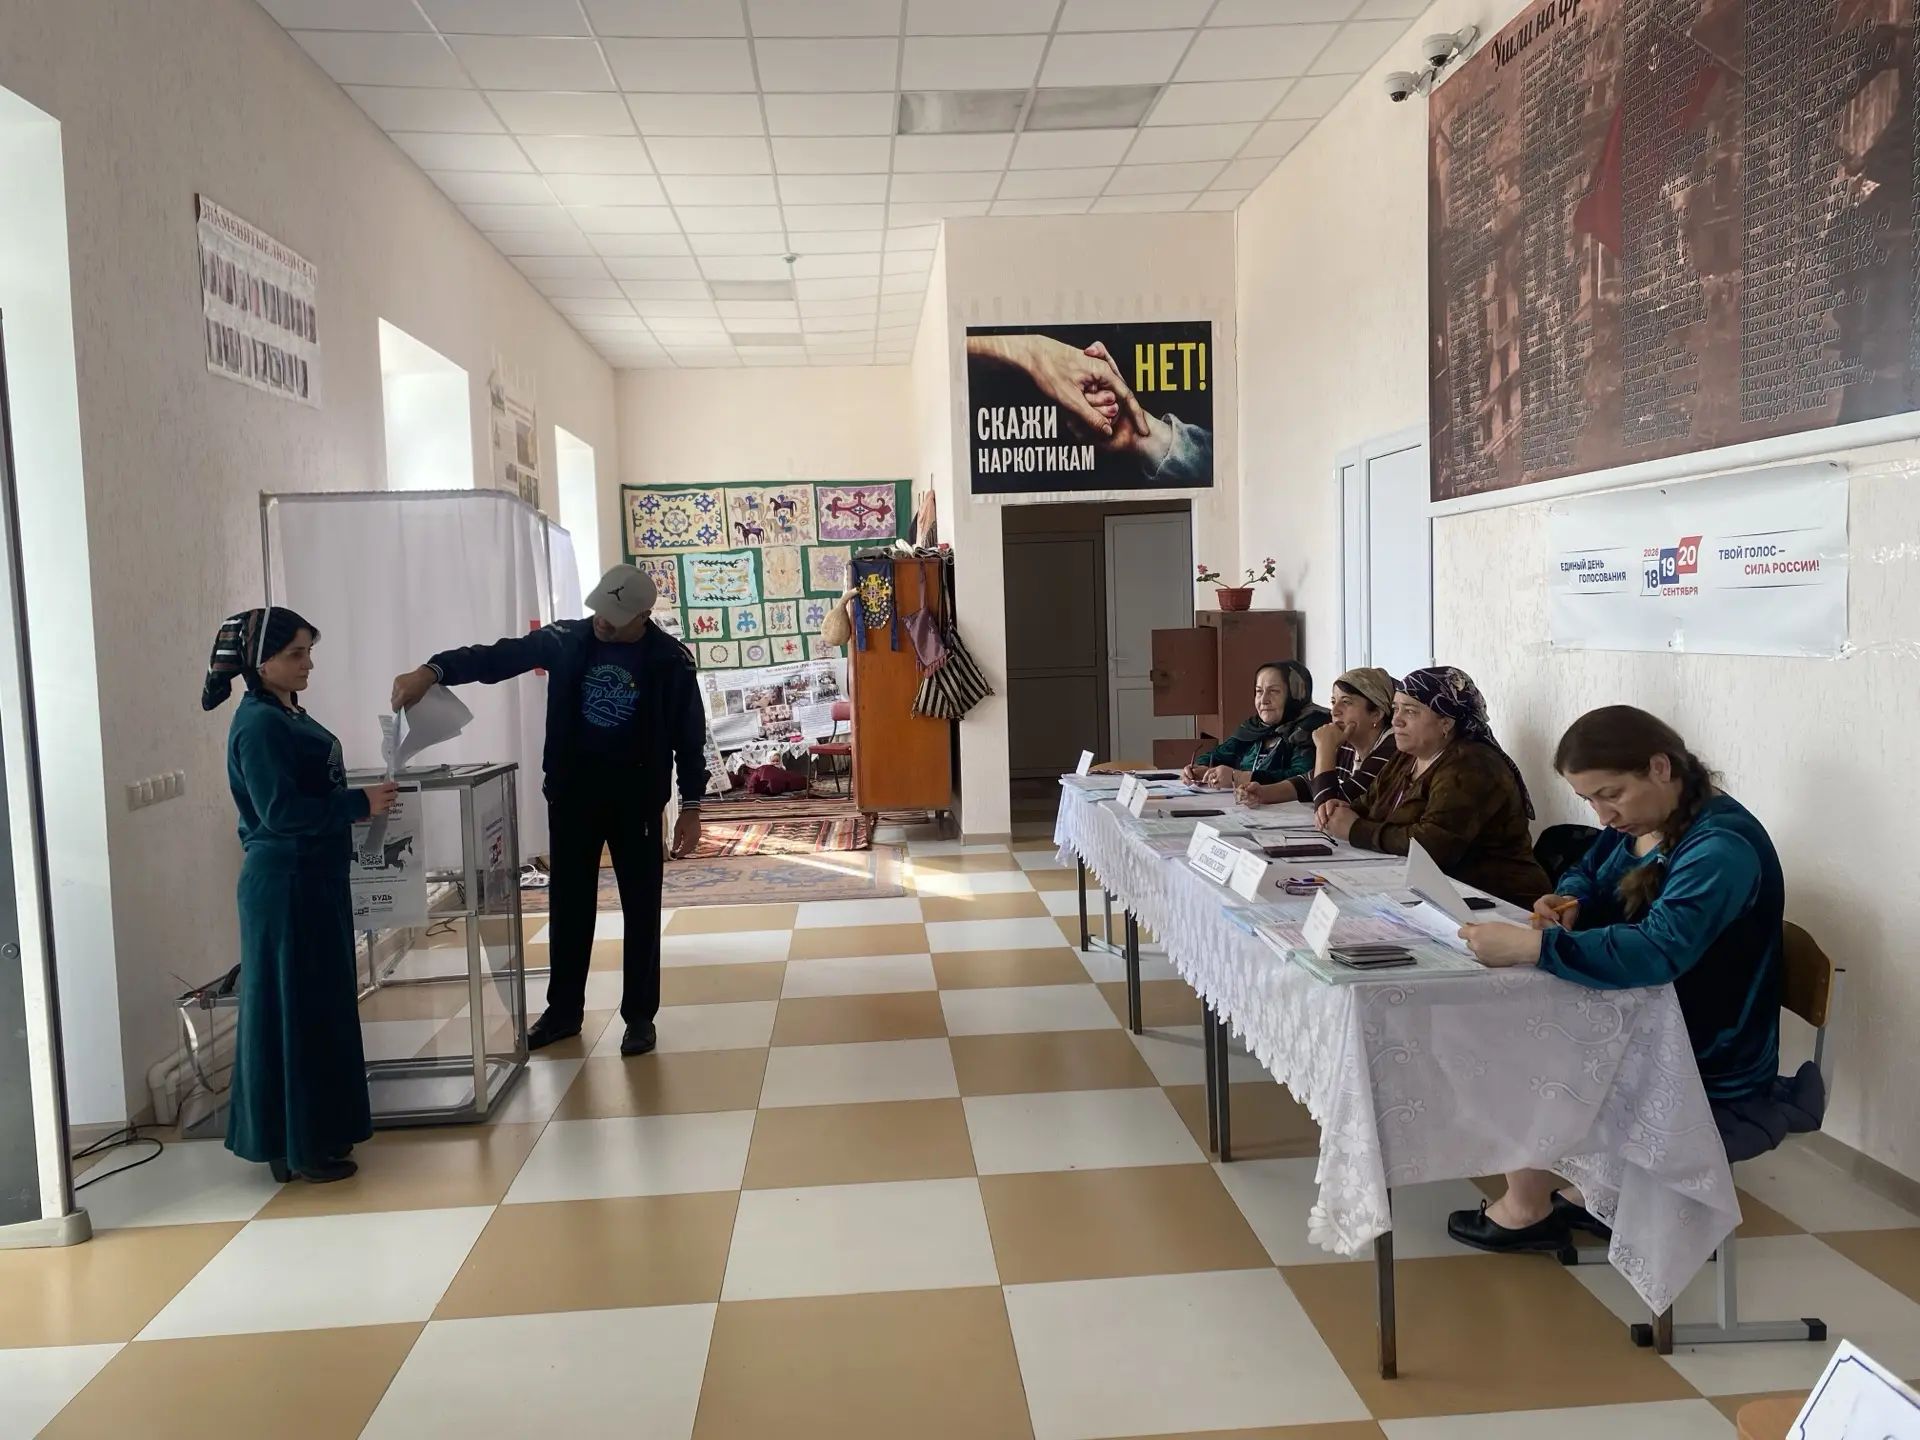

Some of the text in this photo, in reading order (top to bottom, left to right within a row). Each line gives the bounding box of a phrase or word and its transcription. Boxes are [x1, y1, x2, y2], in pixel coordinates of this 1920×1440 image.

[1491, 20, 1533, 72] Ушли
[1535, 1, 1556, 38] на
[1135, 342, 1207, 392] НЕТ!
[977, 405, 1057, 440] СКАЖИ
[978, 445, 1095, 473] НАРКОТИКАМ
[1718, 546, 1743, 560] ТВОЙ
[1744, 545, 1776, 559] ГОЛОС
[1560, 558, 1605, 572] ЕДИНЫЙ ДЕНЬ
[1644, 545, 1697, 589] 18 19 20
[1744, 559, 1820, 576] СИЛА РОССИИ!
[1578, 571, 1627, 584] ГОЛОСОВАНИЯ
[1662, 586, 1699, 597] СЕНТЯБРЯ
[372, 894, 393, 902] БУДЬ
